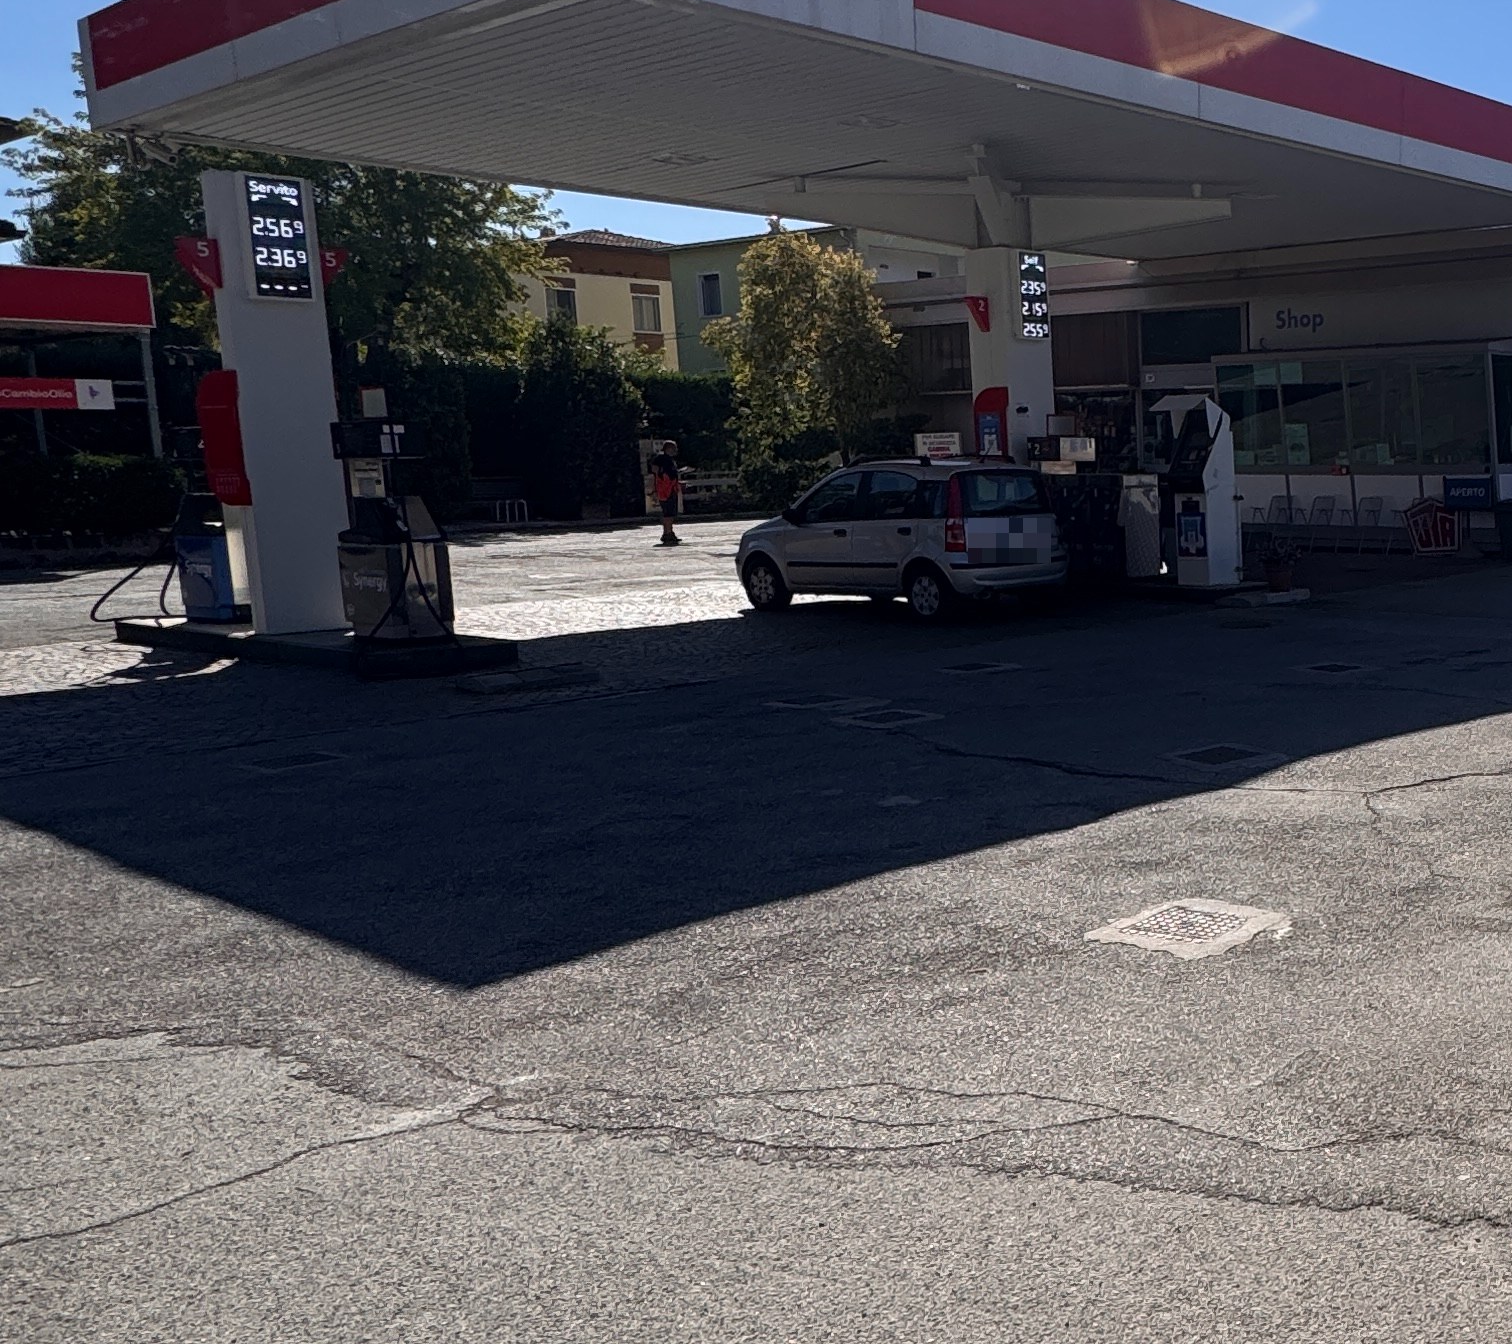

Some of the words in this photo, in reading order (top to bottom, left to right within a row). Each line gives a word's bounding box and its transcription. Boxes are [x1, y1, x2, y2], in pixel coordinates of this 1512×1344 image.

[248, 180, 298, 196] Servito
[196, 241, 209, 257] 5
[324, 252, 337, 267] 5
[978, 299, 985, 312] 2
[1276, 308, 1324, 333] Shop
[1449, 487, 1486, 497] APERTO
[353, 571, 387, 593] Synergy
